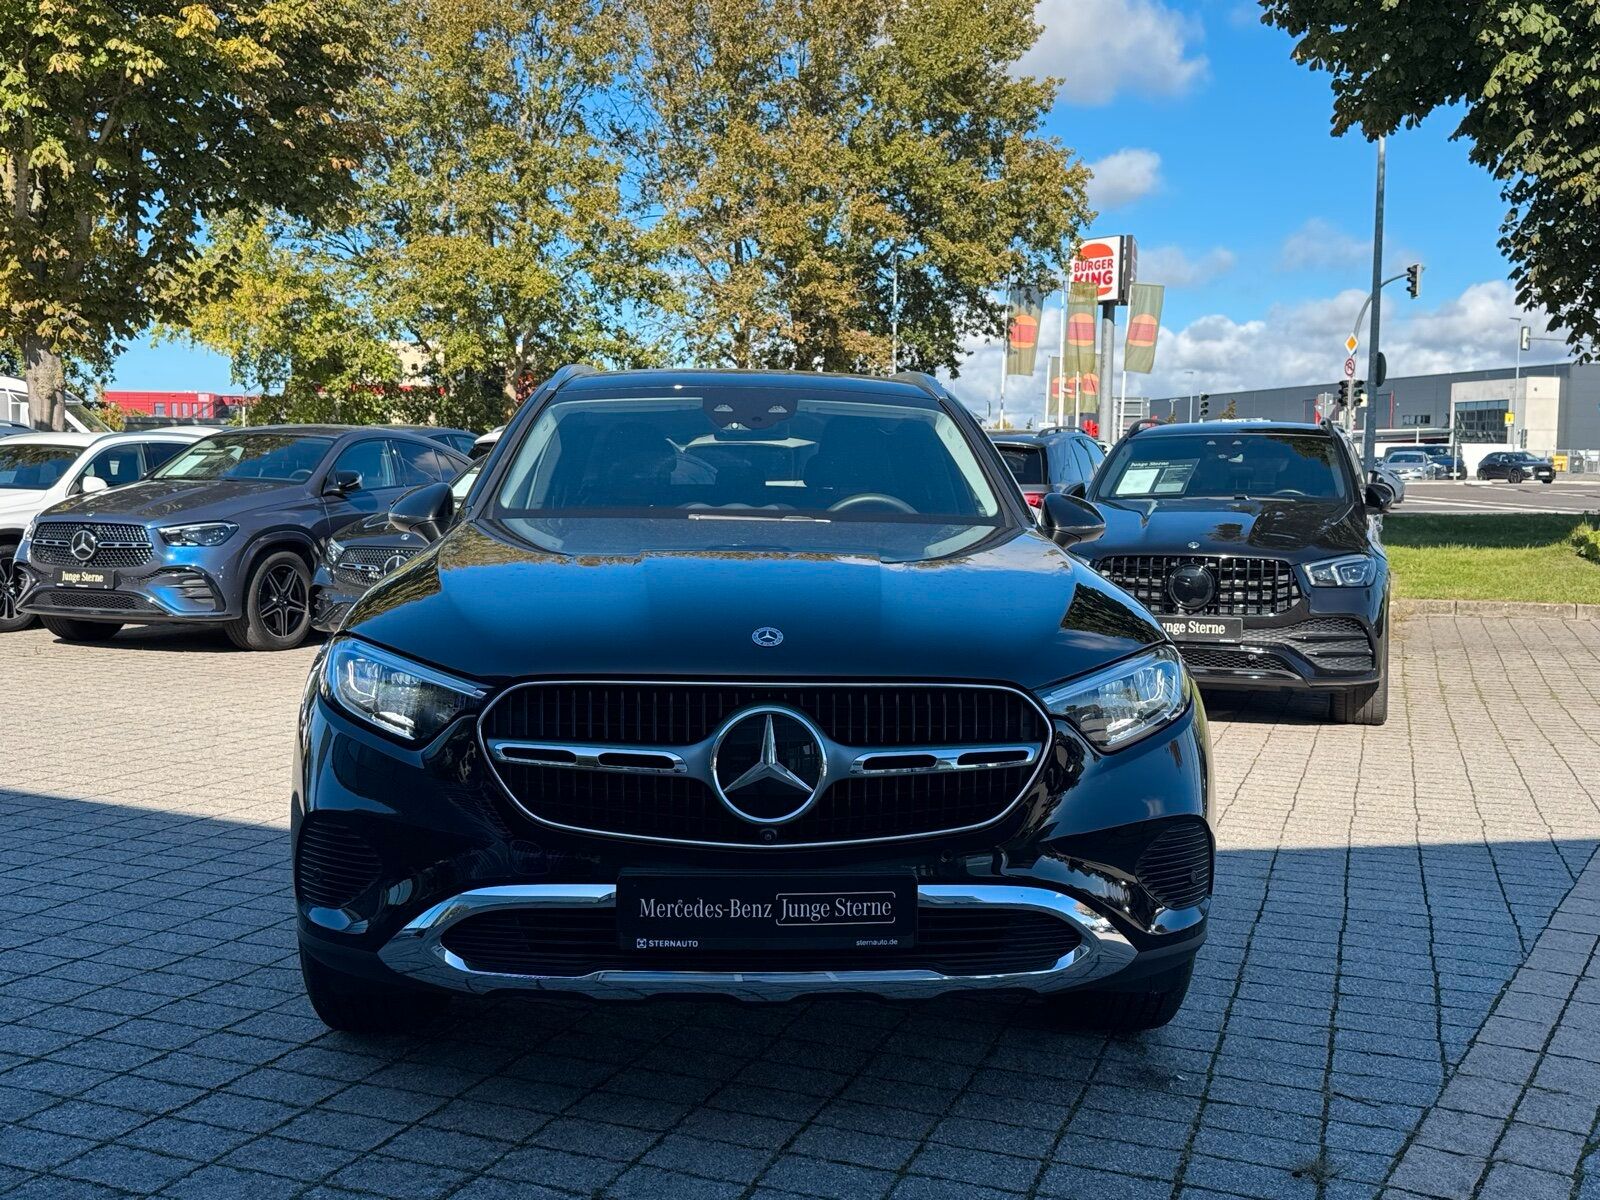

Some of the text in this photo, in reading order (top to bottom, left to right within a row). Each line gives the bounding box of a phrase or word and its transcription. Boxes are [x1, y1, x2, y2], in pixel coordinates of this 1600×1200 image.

[1074, 258, 1113, 272] BURGER
[1073, 270, 1113, 286] KING
[62, 570, 104, 583] Junge Sterne
[1188, 620, 1226, 634] Sterne
[639, 897, 892, 922] Mercedes-Benz Junge Sterne
[648, 939, 699, 948] STERNAUTO
